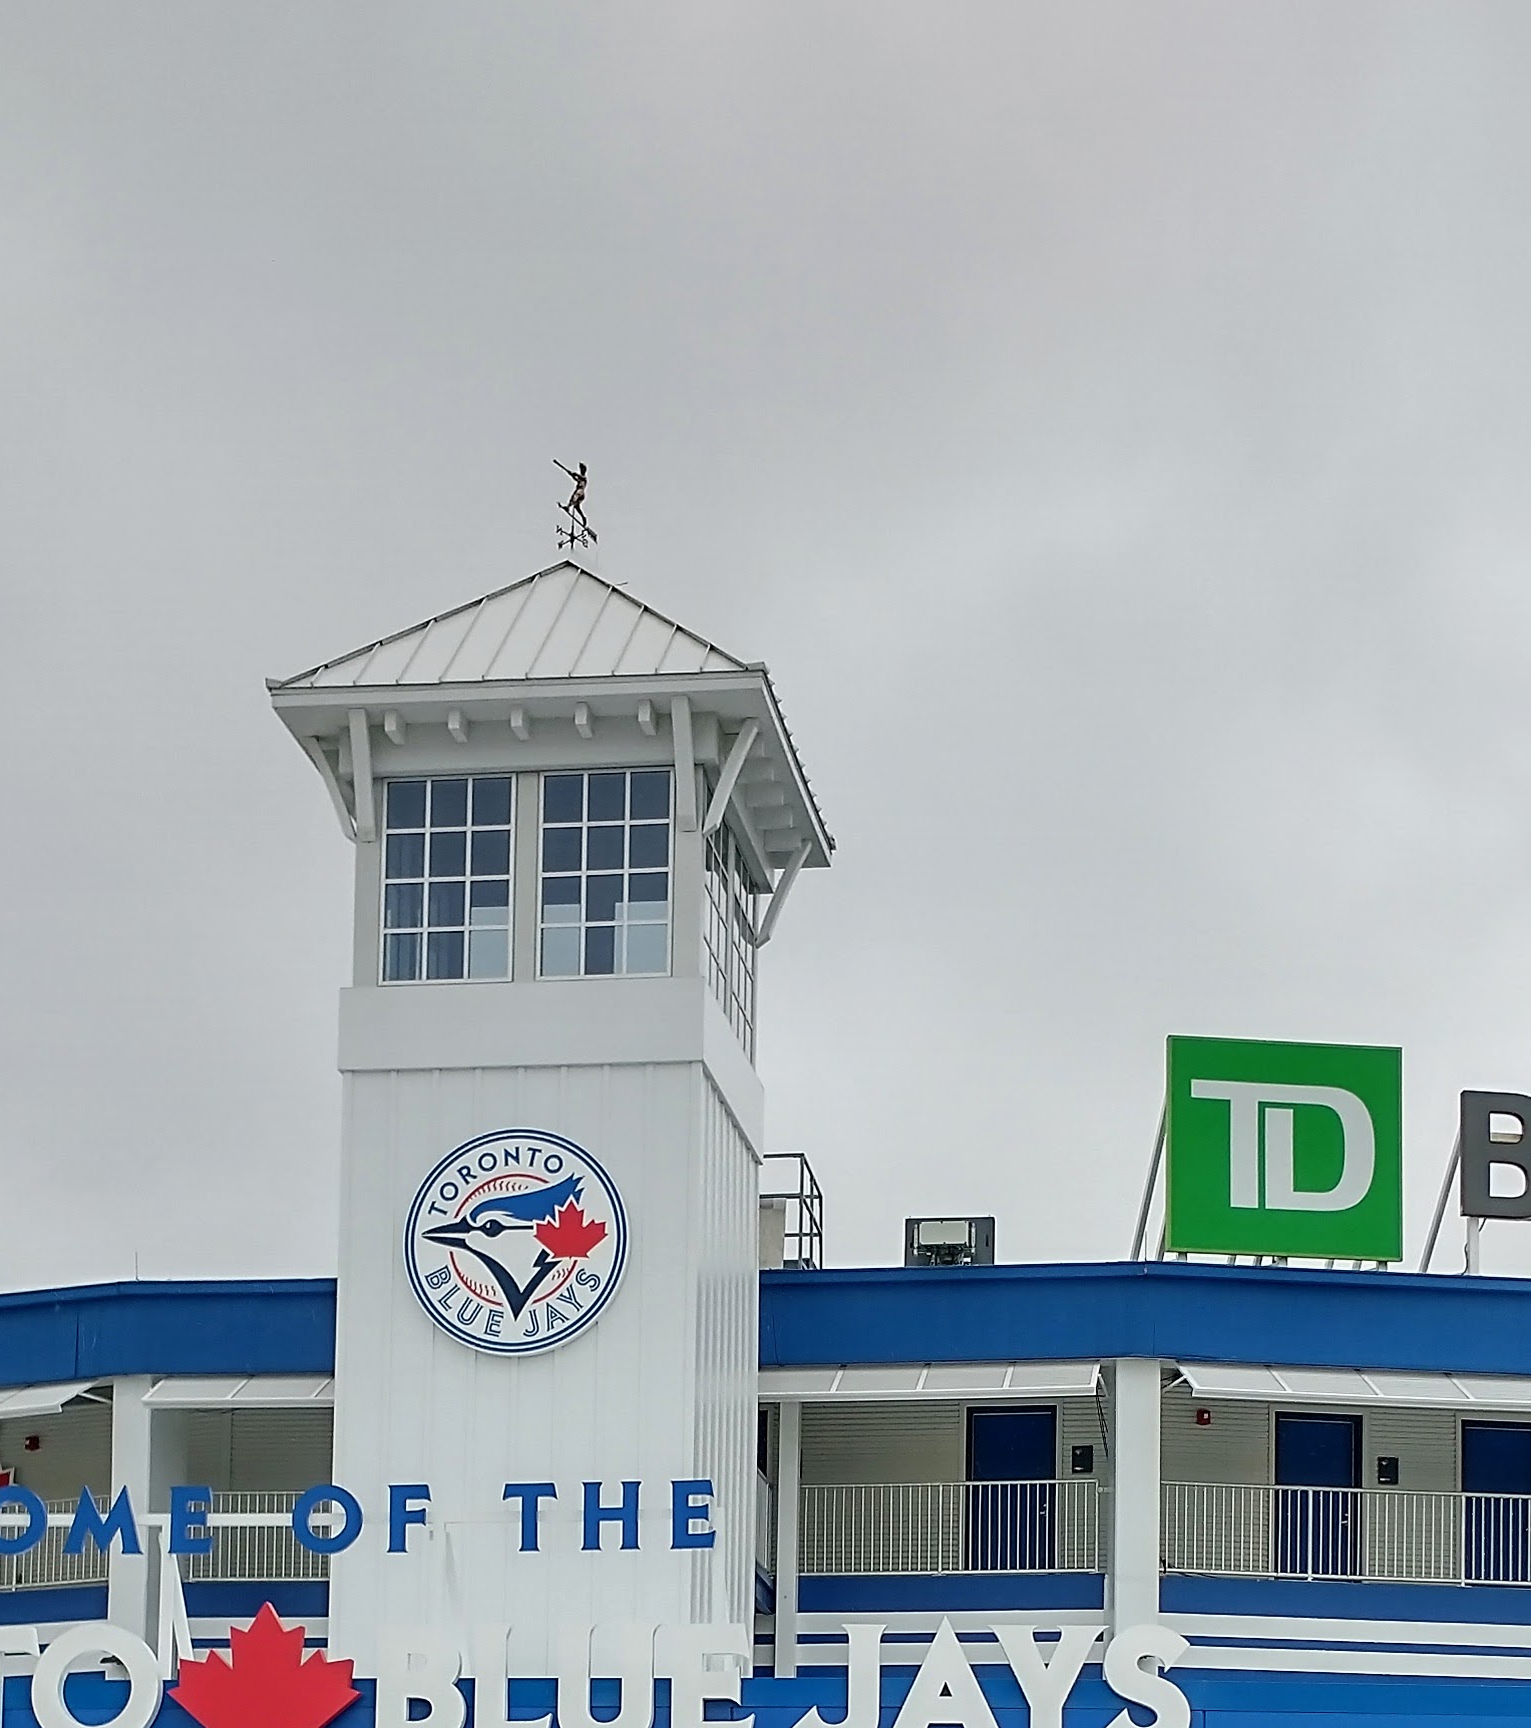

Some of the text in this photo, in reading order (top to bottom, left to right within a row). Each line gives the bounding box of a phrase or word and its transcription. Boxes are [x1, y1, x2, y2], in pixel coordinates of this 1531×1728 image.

[1191, 1079, 1375, 1211] TD
[428, 1147, 563, 1217] TORONTO
[425, 1265, 601, 1337] BLUE JAYS
[292, 1483, 432, 1554] OF
[502, 1479, 717, 1552] THE
